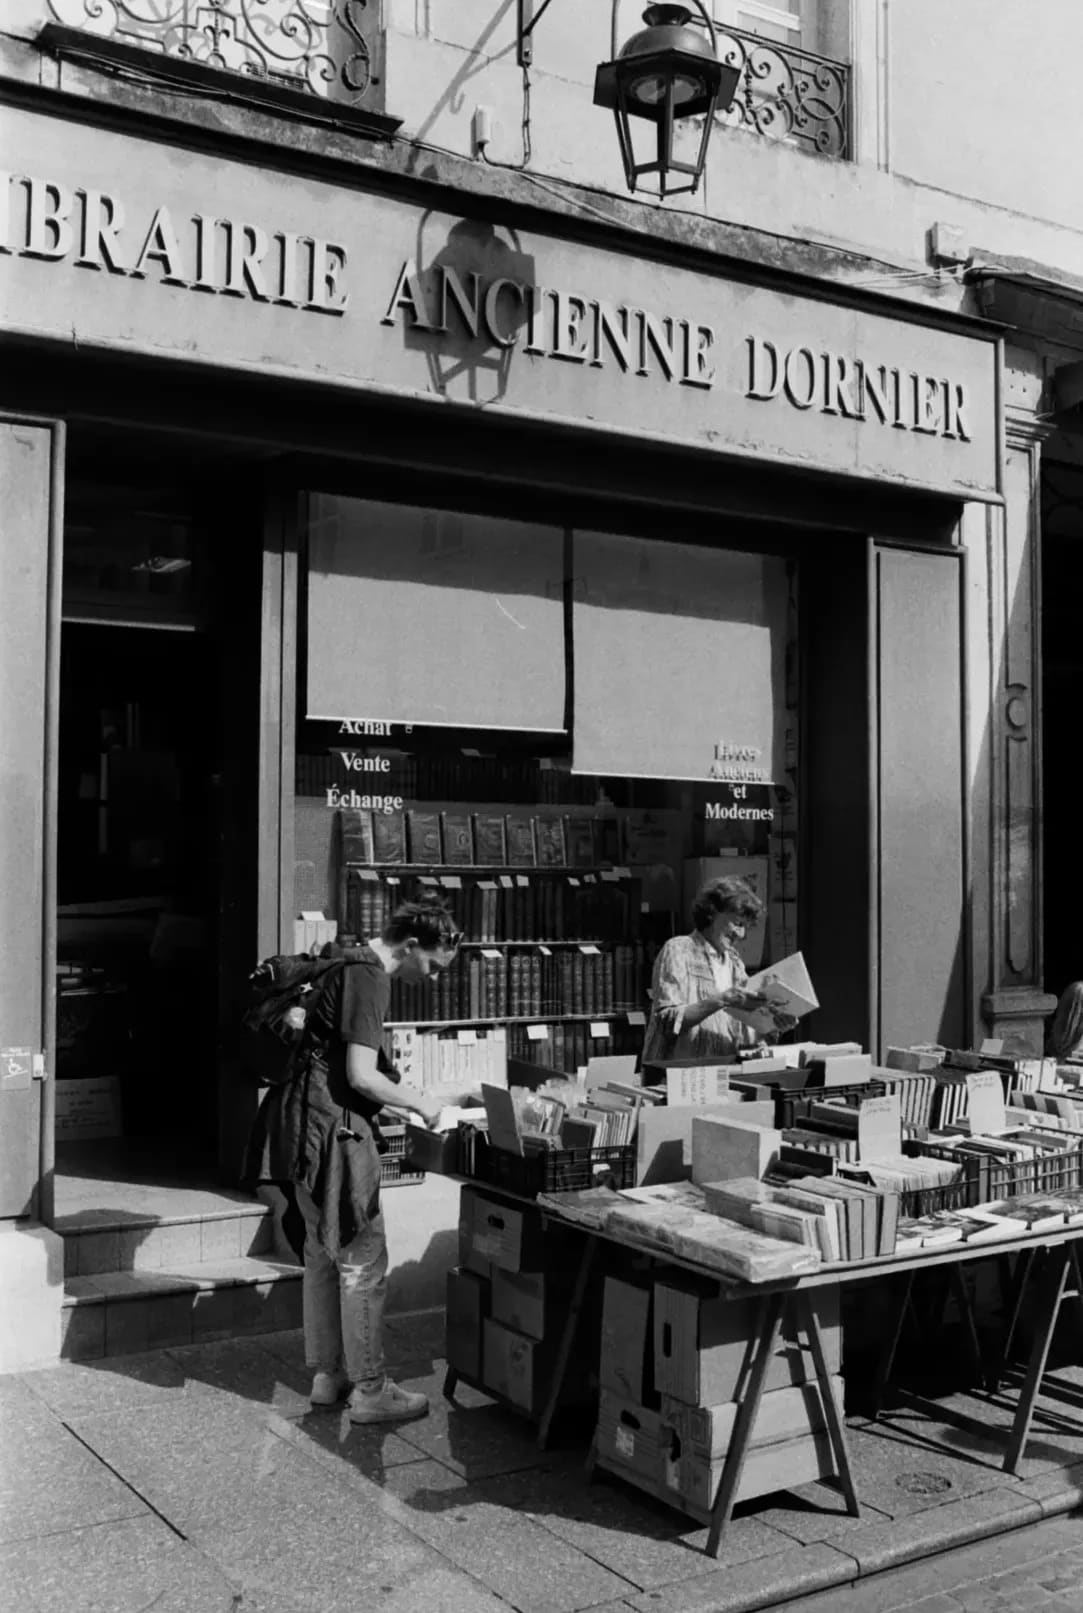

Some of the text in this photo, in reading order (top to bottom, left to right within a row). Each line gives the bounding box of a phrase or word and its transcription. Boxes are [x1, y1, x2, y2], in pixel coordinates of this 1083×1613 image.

[381, 257, 715, 389] ANCIENNE
[745, 334, 971, 443] DORNIER
[341, 752, 391, 772] Vente
[326, 783, 403, 814] Échange
[733, 784, 747, 799] et
[705, 802, 774, 820] Modernes
